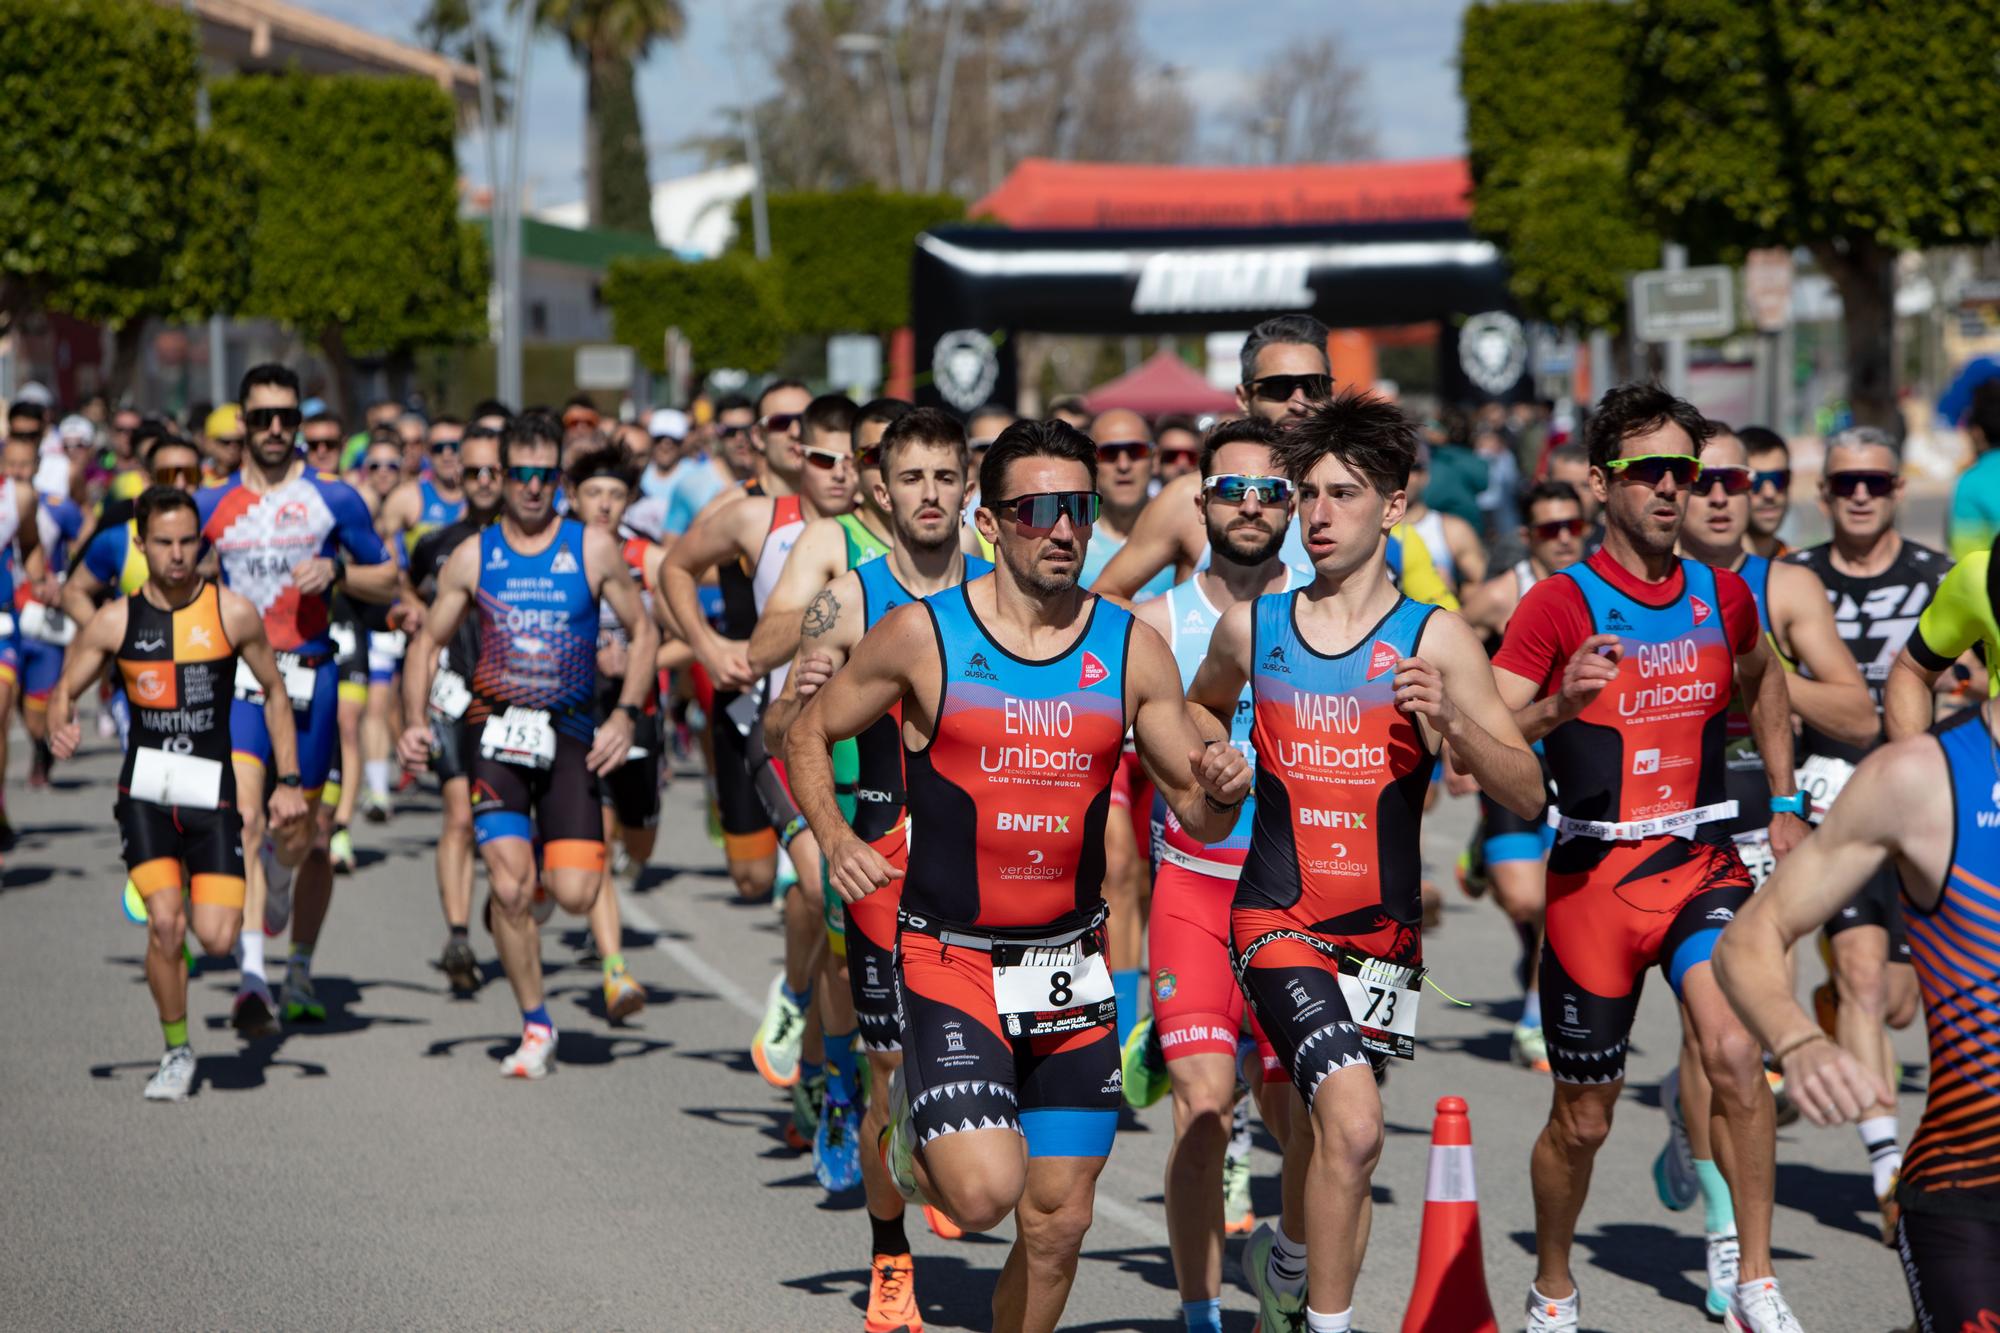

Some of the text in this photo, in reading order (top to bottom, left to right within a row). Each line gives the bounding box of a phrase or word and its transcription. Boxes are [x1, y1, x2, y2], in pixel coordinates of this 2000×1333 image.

[494, 604, 570, 631] LÓPEZ
[1638, 638, 1698, 678] GARIJO
[1618, 680, 1716, 716] UniData
[141, 707, 214, 733] MARTÍNEZ
[1004, 697, 1073, 738] ENNIO
[1294, 692, 1360, 734] MARIO
[503, 724, 543, 747] 153
[980, 743, 1093, 773] UniData
[1278, 740, 1385, 768] UniData
[988, 775, 1081, 788] CLUB TRIATLON MURCIA
[1287, 770, 1305, 780] CLUB
[1306, 774, 1347, 785] TRIATLON
[996, 812, 1070, 833] BNFIX
[1299, 807, 1368, 829] BNFIX
[999, 865, 1063, 878] verdolay
[1306, 859, 1368, 875] verdolay
[1048, 971, 1073, 1007] 8
[1362, 986, 1398, 1027] 73
[936, 1054, 980, 1064] Ayuntamiento
